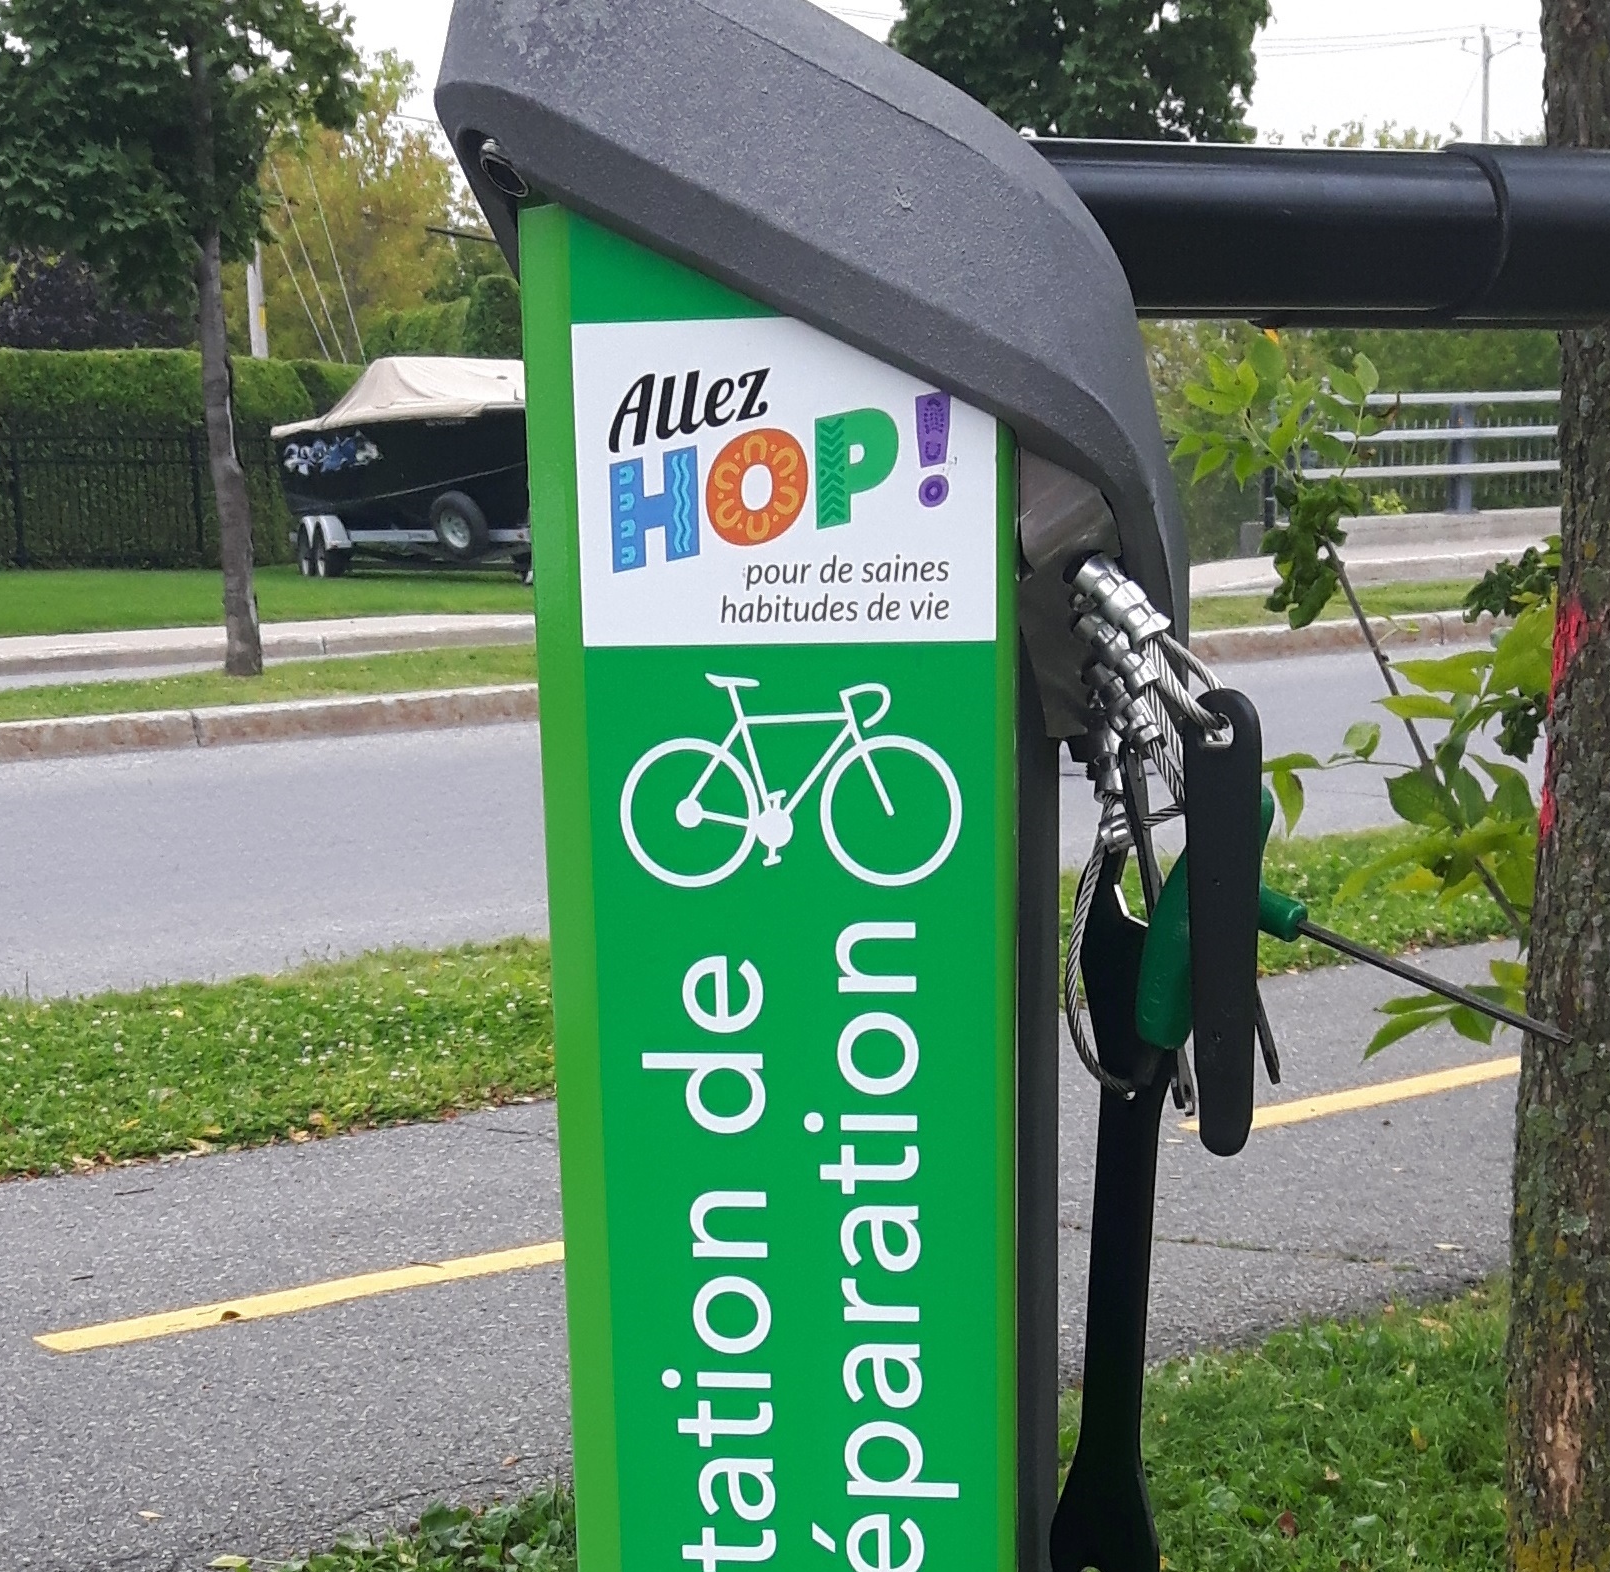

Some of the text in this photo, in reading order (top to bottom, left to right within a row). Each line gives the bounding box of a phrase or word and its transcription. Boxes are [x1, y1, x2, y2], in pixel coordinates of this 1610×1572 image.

[609, 368, 771, 454] Allez
[609, 390, 952, 574] HOP!
[720, 591, 950, 624] habitudes de vie
[744, 553, 950, 591] pour de saines
[641, 955, 765, 1134] de
